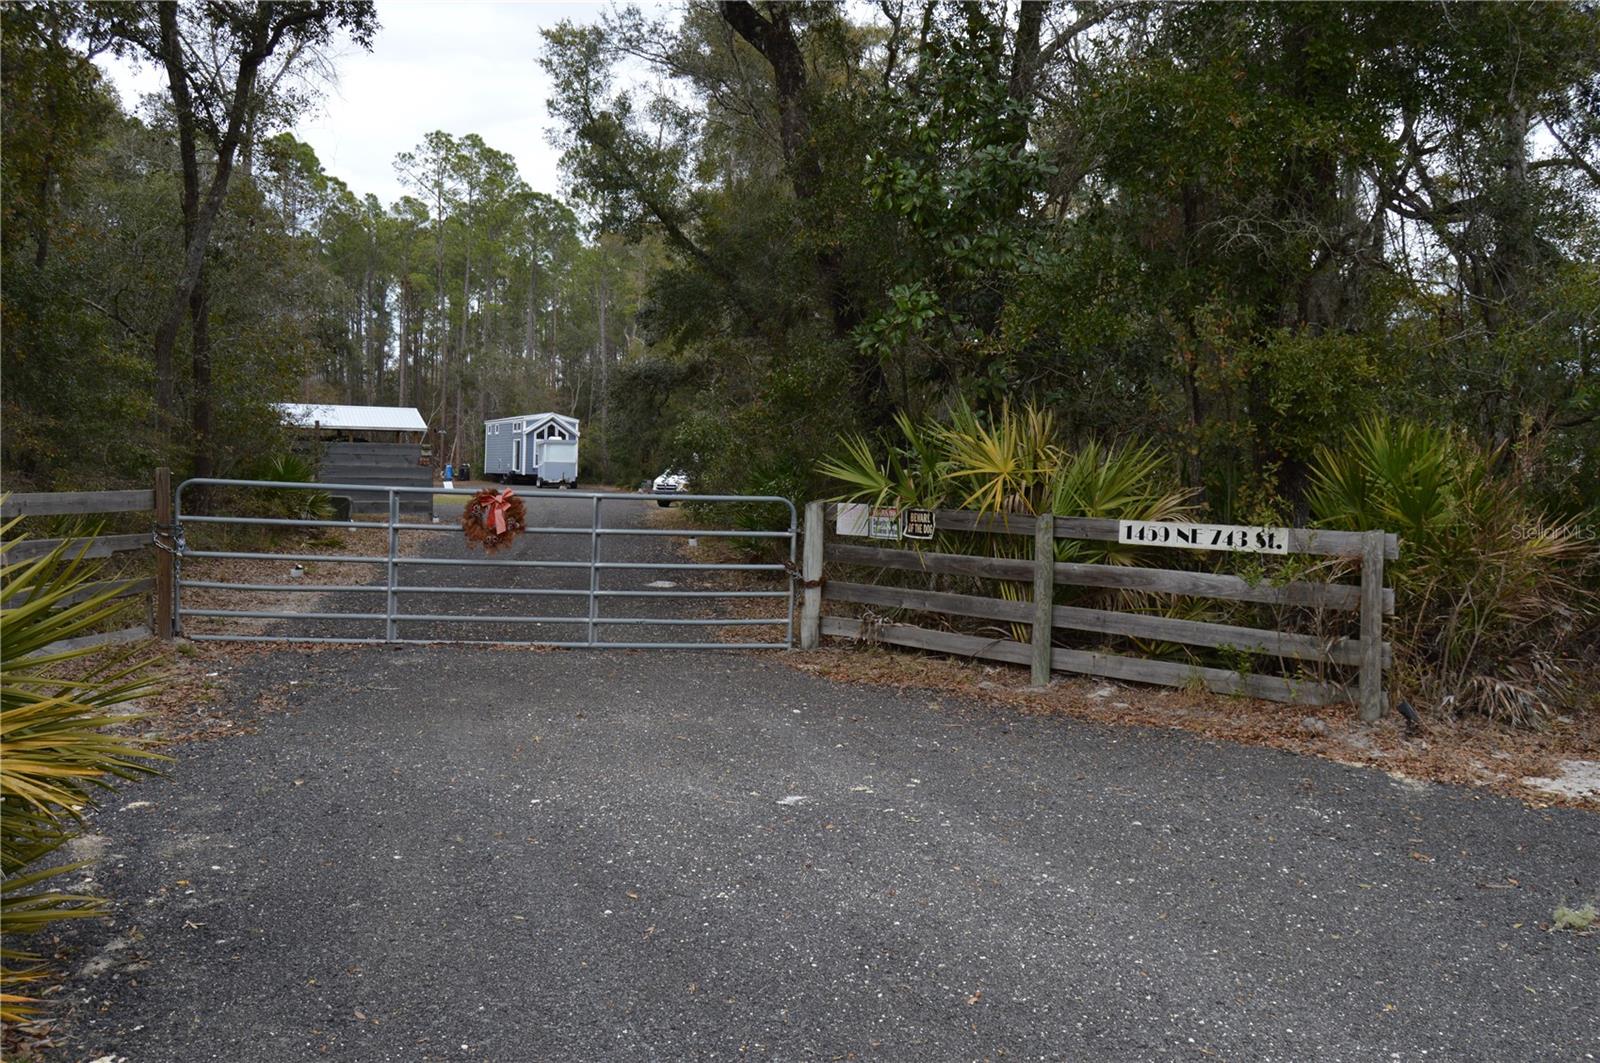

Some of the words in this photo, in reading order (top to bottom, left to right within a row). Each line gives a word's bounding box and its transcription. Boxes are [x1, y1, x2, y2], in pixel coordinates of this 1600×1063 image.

[910, 512, 931, 523] BEWARE
[908, 524, 914, 533] OF
[914, 524, 923, 534] THE
[923, 524, 933, 534] DOG
[1124, 525, 1170, 542] 1459
[1177, 528, 1203, 545] NE
[1209, 529, 1247, 547] 743
[1255, 531, 1282, 550] St.
